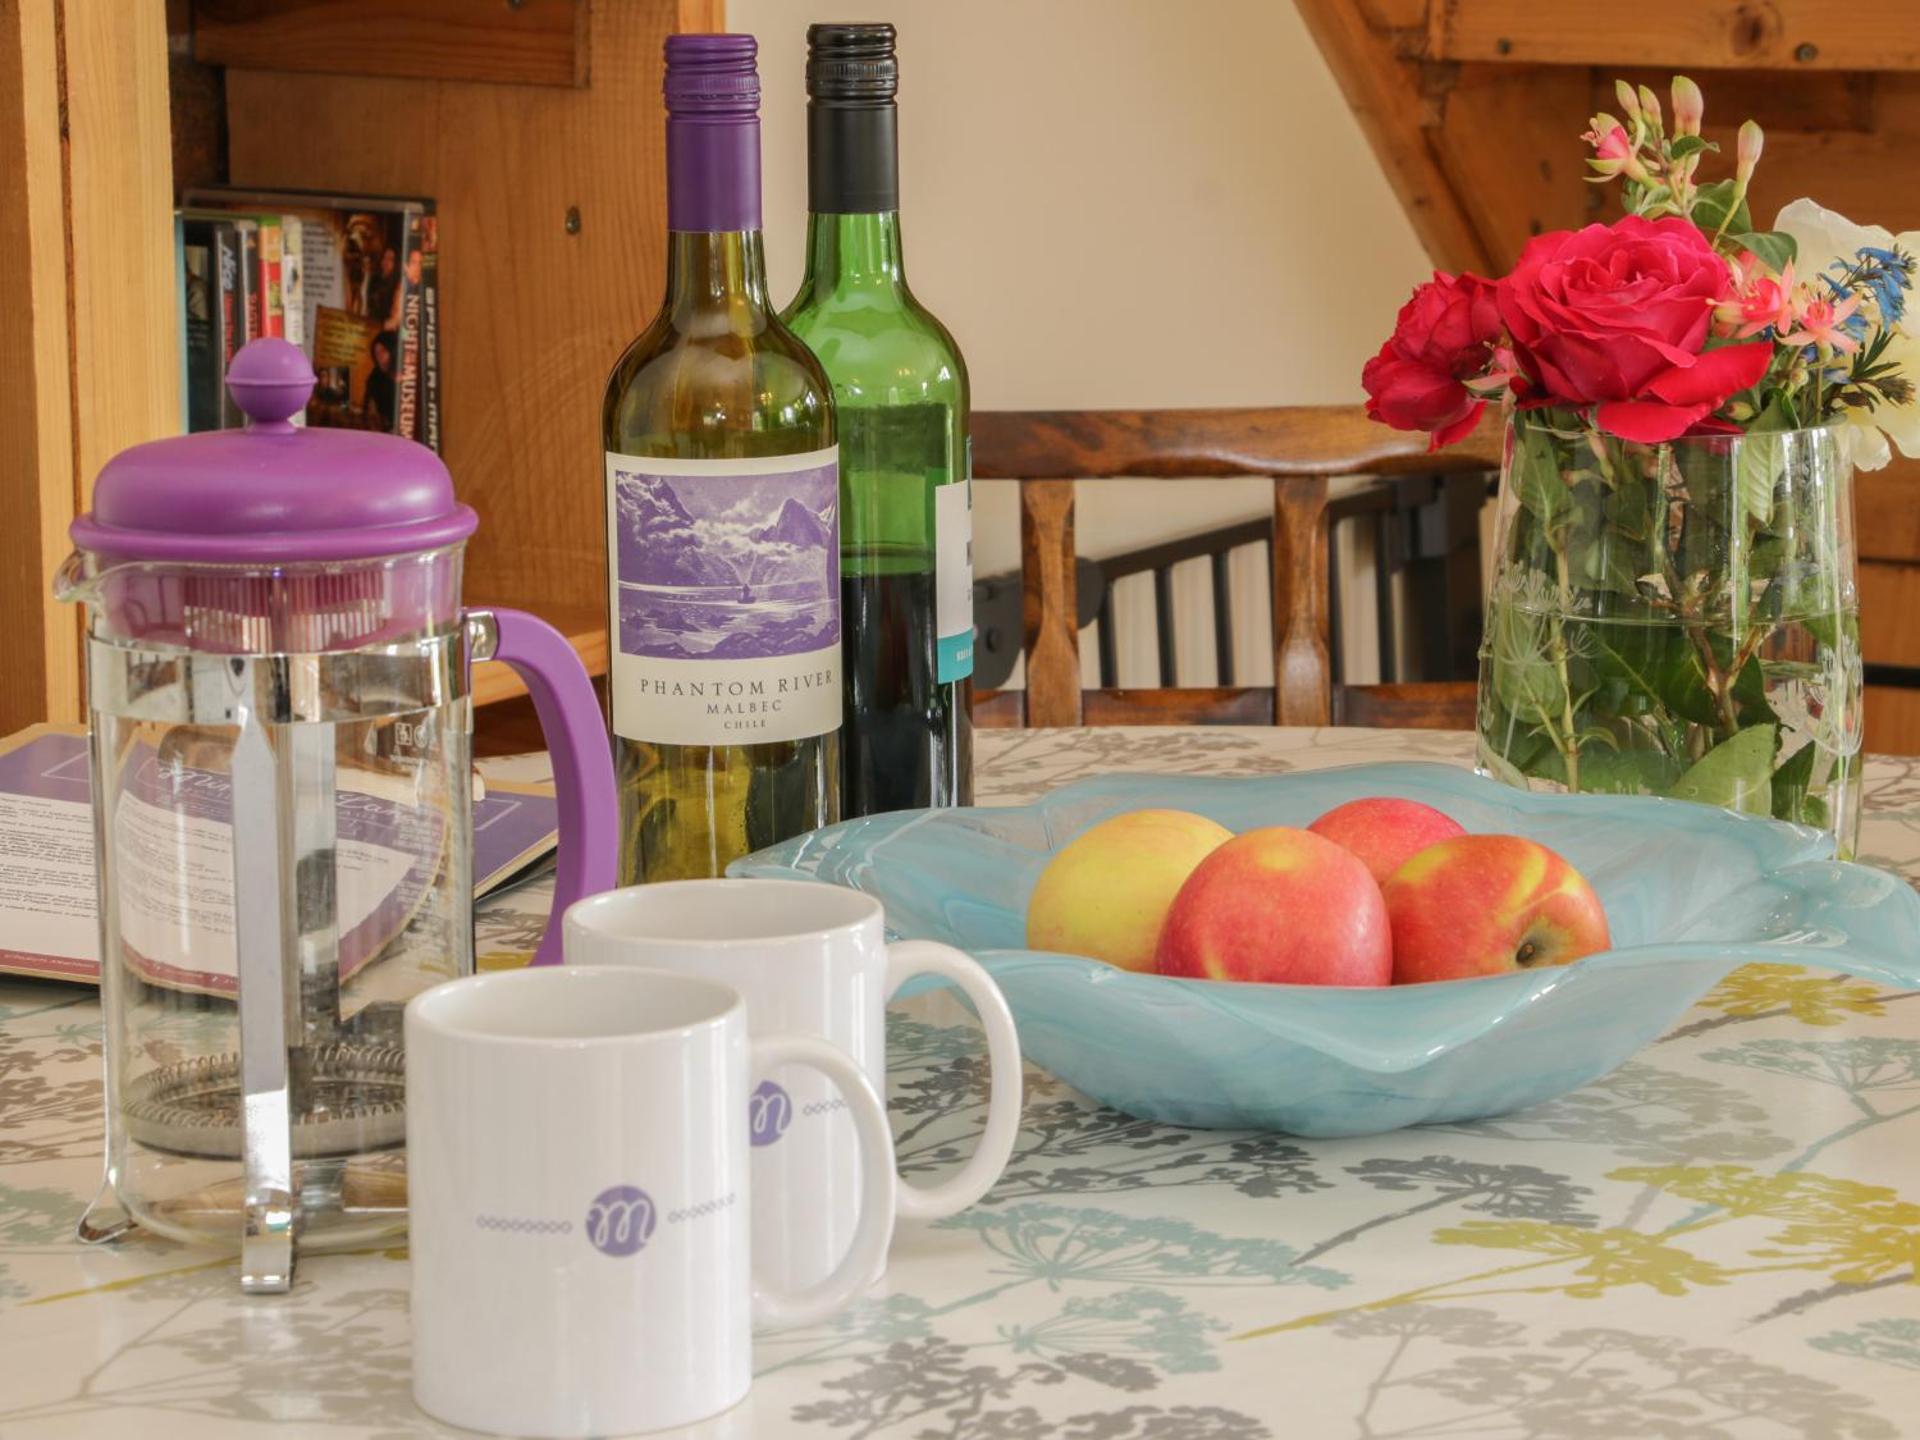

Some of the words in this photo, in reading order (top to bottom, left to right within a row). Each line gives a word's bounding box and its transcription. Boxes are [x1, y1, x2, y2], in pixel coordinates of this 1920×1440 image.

[404, 294, 419, 348] NIGHT
[400, 364, 417, 440] MUSEUM
[640, 678, 765, 697] PHANTOM
[778, 669, 833, 693] RIVER
[706, 700, 783, 714] MALBEC
[723, 719, 767, 729] CHILE
